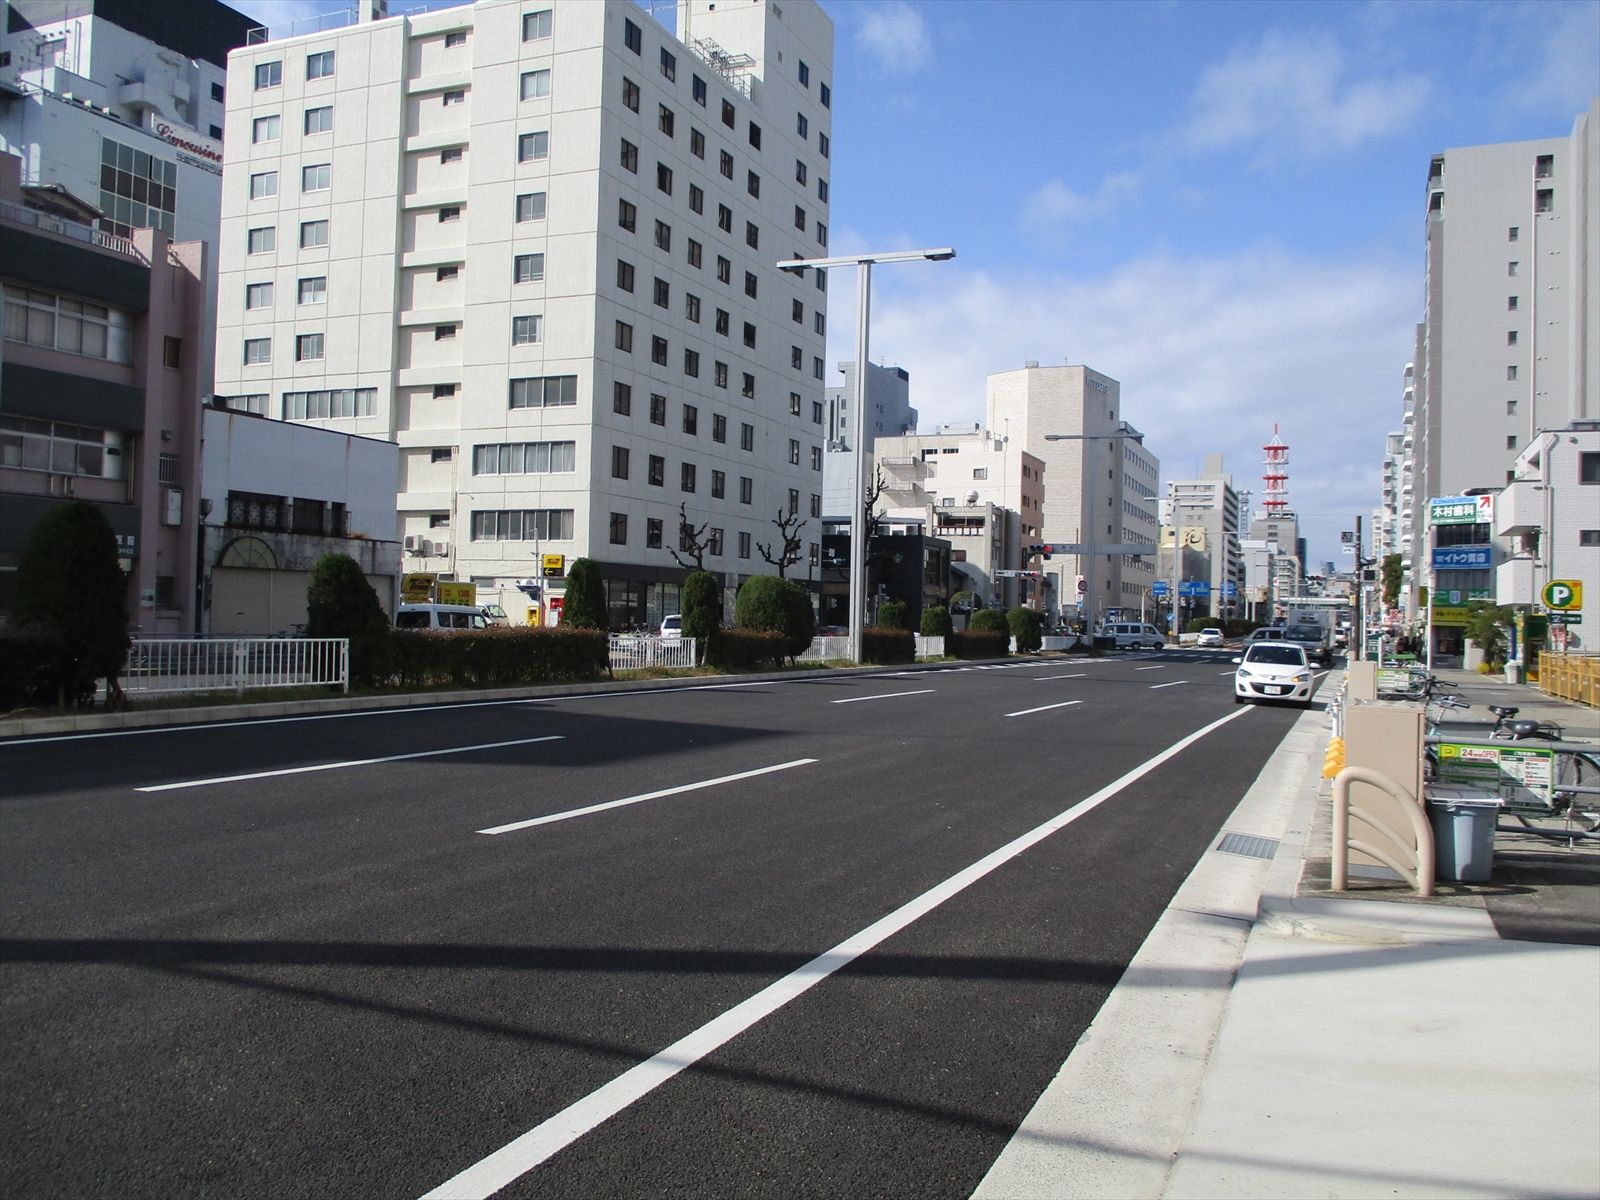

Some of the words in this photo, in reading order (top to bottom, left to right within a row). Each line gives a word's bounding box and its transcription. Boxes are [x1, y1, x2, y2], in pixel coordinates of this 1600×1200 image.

[1433, 505, 1474, 517] 木村歯科
[1553, 586, 1570, 605] P
